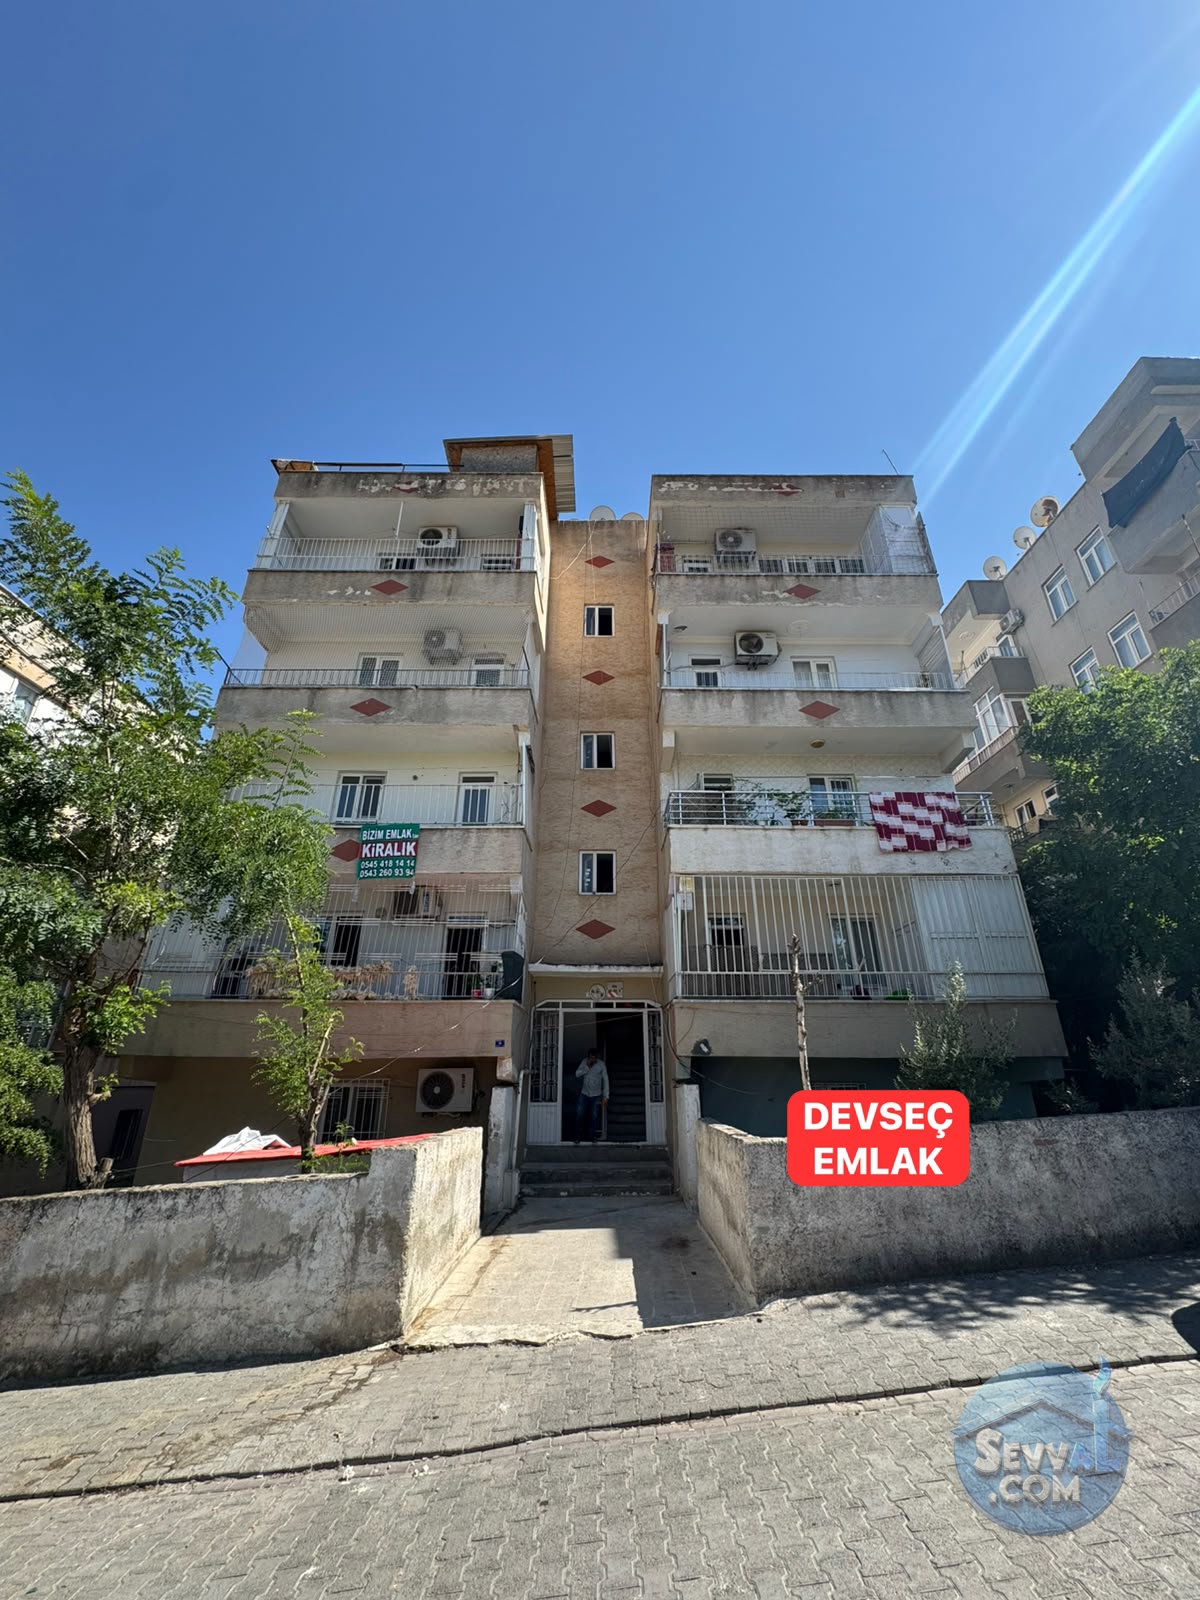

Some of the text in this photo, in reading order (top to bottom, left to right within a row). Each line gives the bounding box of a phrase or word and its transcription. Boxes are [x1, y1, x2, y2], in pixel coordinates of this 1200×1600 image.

[362, 828, 384, 840] BİZİM
[386, 829, 412, 839] EMLAK
[360, 869, 377, 877] 0543
